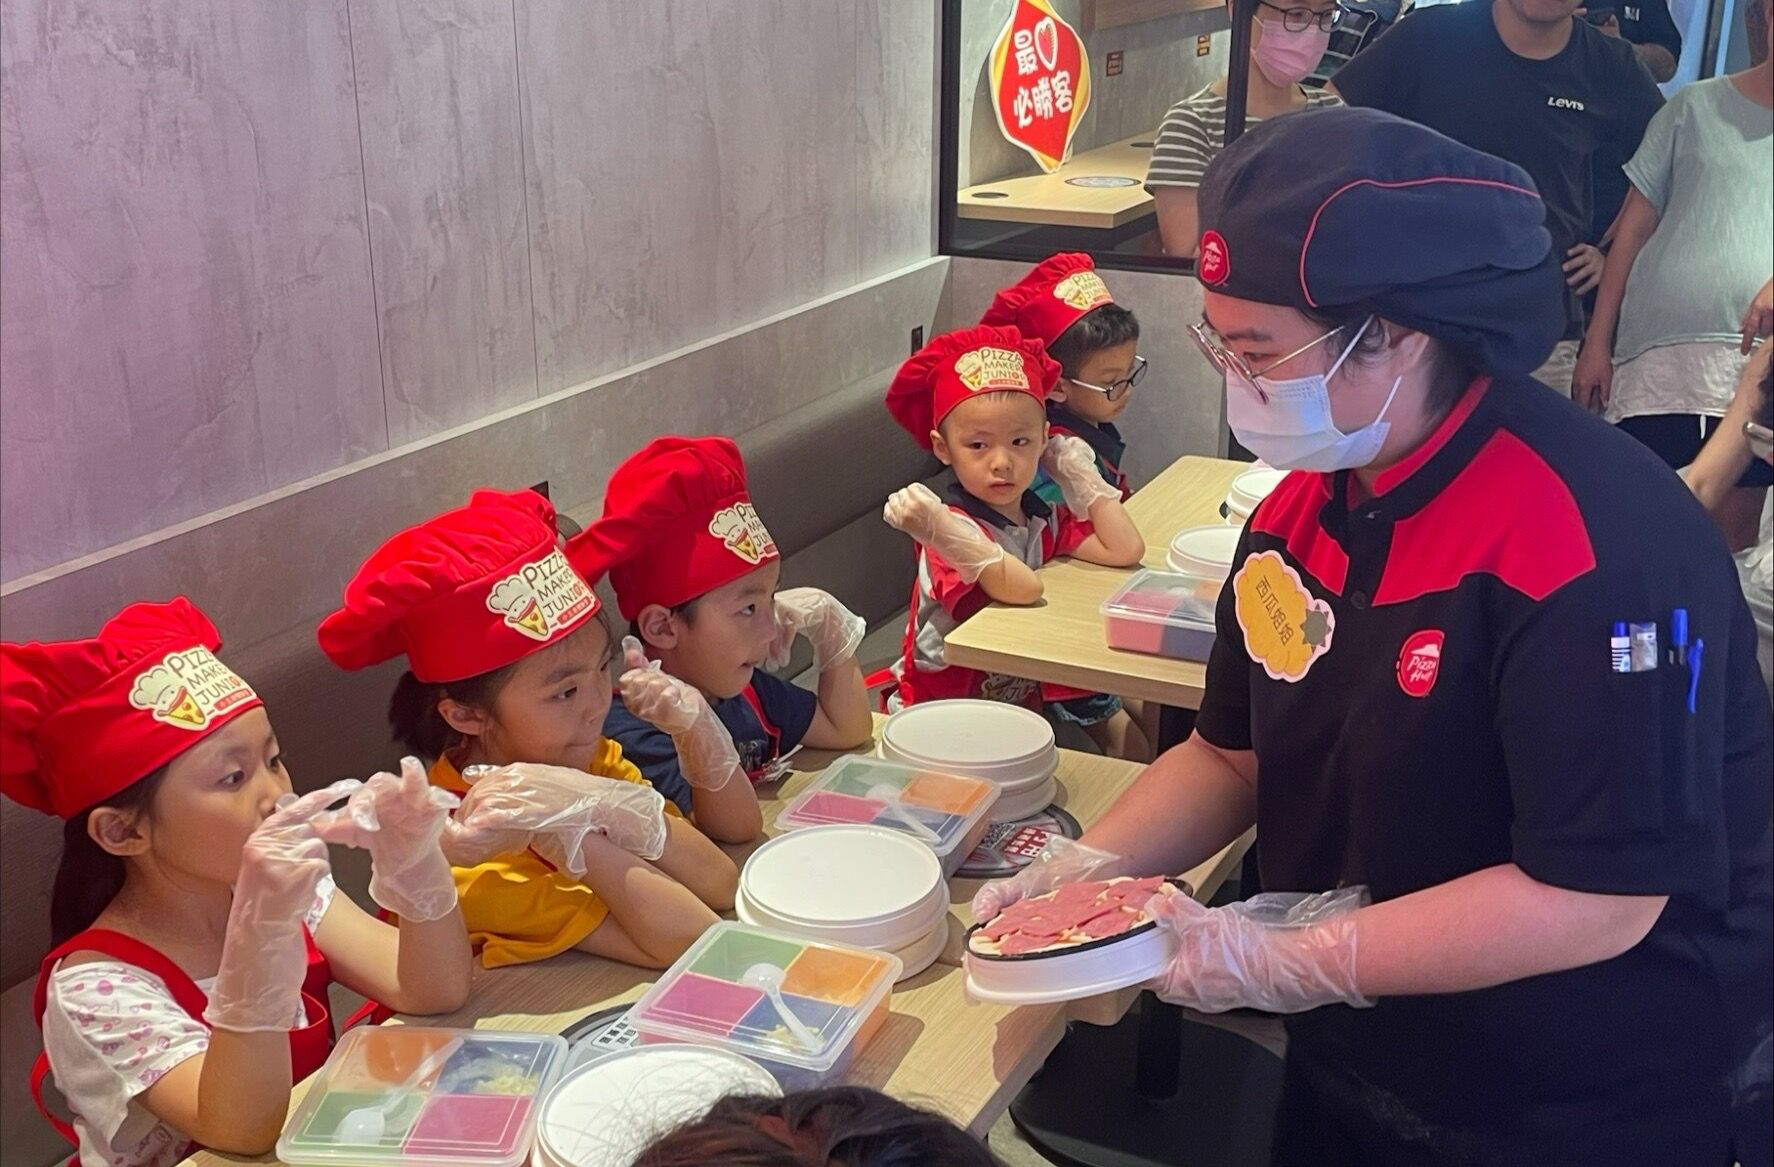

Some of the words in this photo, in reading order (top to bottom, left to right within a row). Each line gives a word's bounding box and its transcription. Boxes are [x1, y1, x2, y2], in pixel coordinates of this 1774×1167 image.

[1014, 29, 1038, 75] 最
[1013, 70, 1073, 129] 必勝客
[1255, 575, 1294, 647] 西瓜姐姐
[167, 649, 214, 679] PIZZ
[1407, 655, 1437, 671] Pizza
[1410, 669, 1432, 682] Hut
